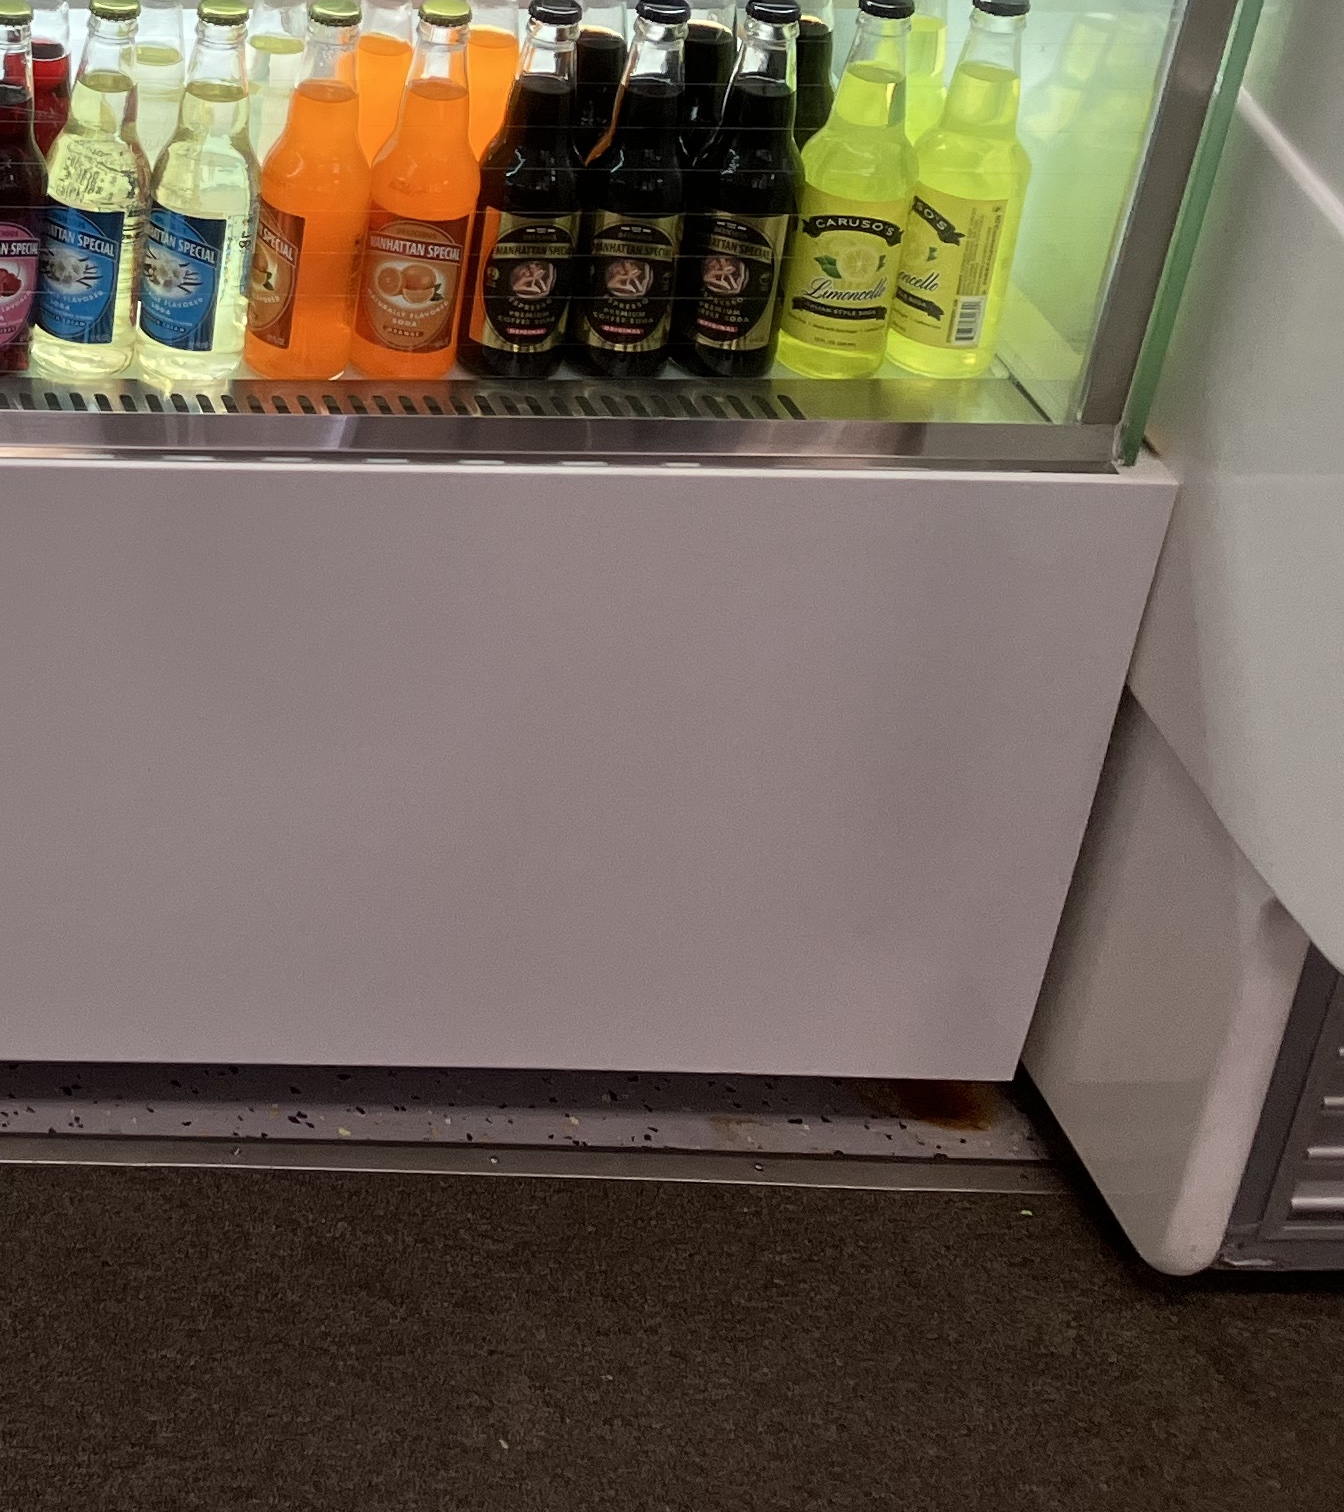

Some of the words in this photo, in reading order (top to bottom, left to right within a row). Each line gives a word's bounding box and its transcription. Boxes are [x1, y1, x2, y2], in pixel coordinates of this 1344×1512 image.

[815, 217, 895, 237] CARUSO'S
[77, 233, 115, 258] SPECIAL
[178, 239, 216, 264] SPECIAL
[261, 228, 294, 263] SPECIAL
[370, 235, 425, 256] MANHATTAN
[427, 245, 461, 261] SPECIAL
[392, 318, 417, 327] SODA
